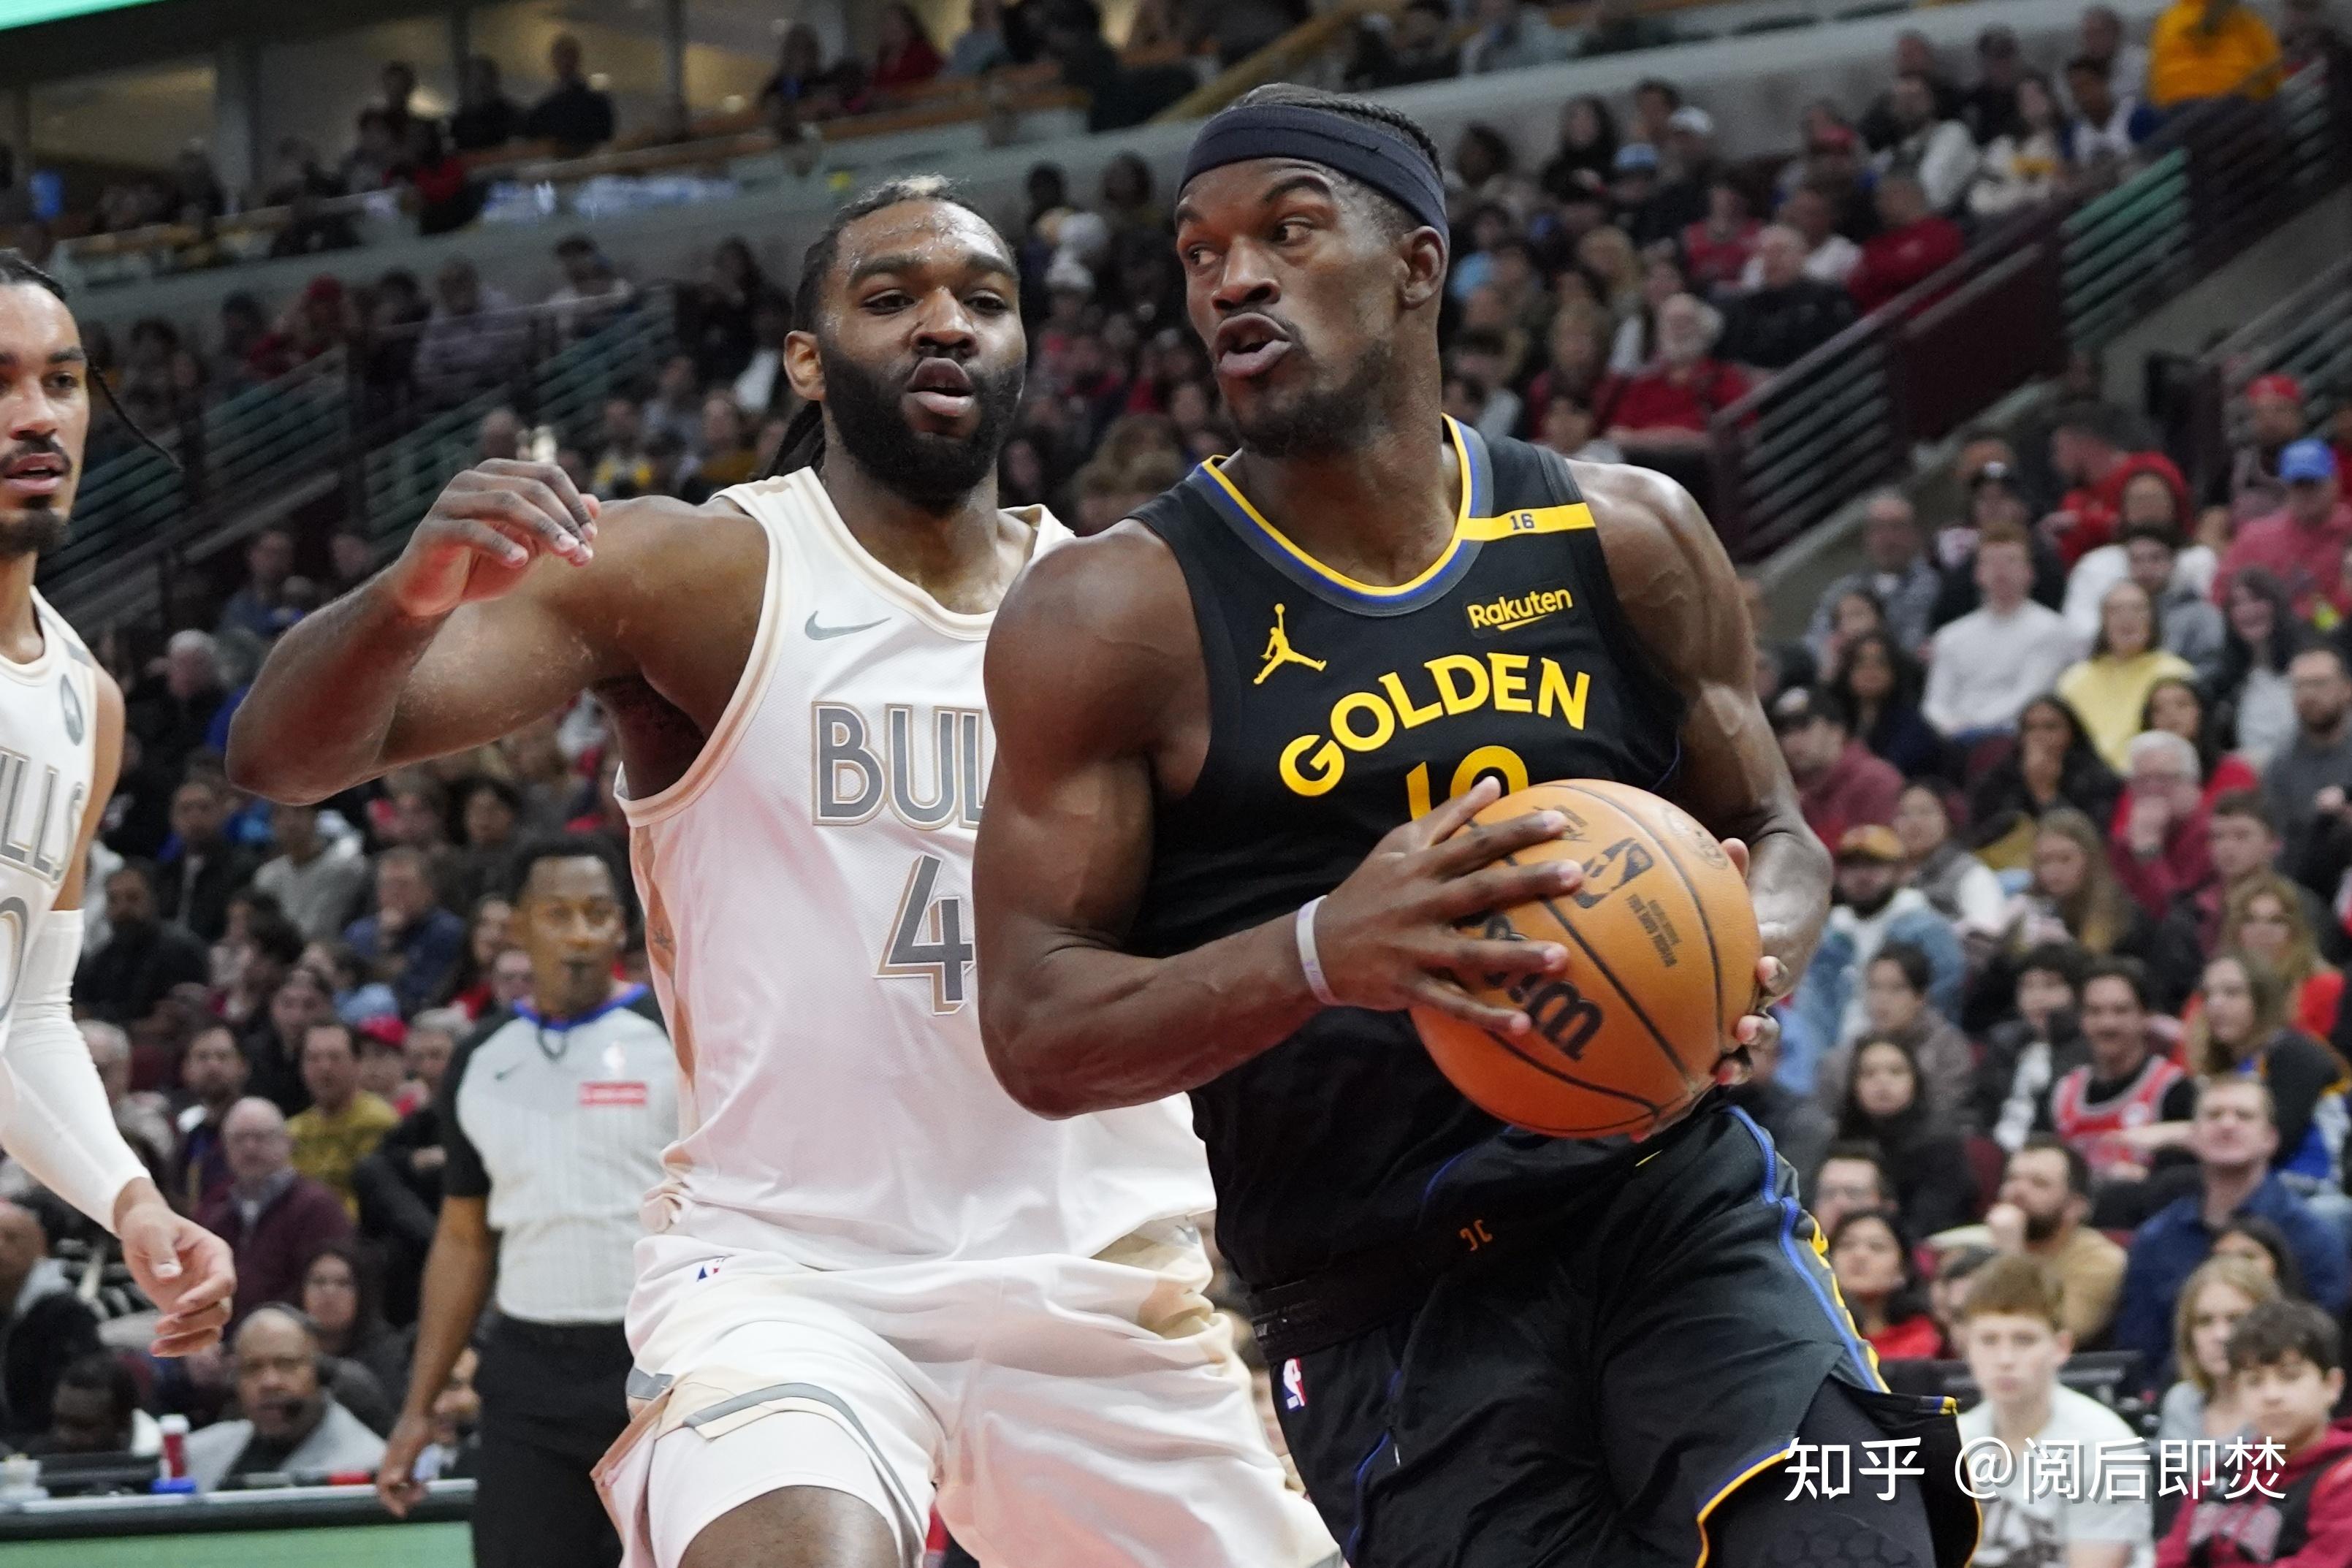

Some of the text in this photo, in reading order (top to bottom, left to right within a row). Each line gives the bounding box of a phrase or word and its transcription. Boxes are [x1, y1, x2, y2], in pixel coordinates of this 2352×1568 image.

[1510, 513, 1535, 531] 16
[1467, 589, 1573, 629] Rakuten
[1279, 652, 1591, 796] GOLDEN
[873, 854, 976, 1016] 4
